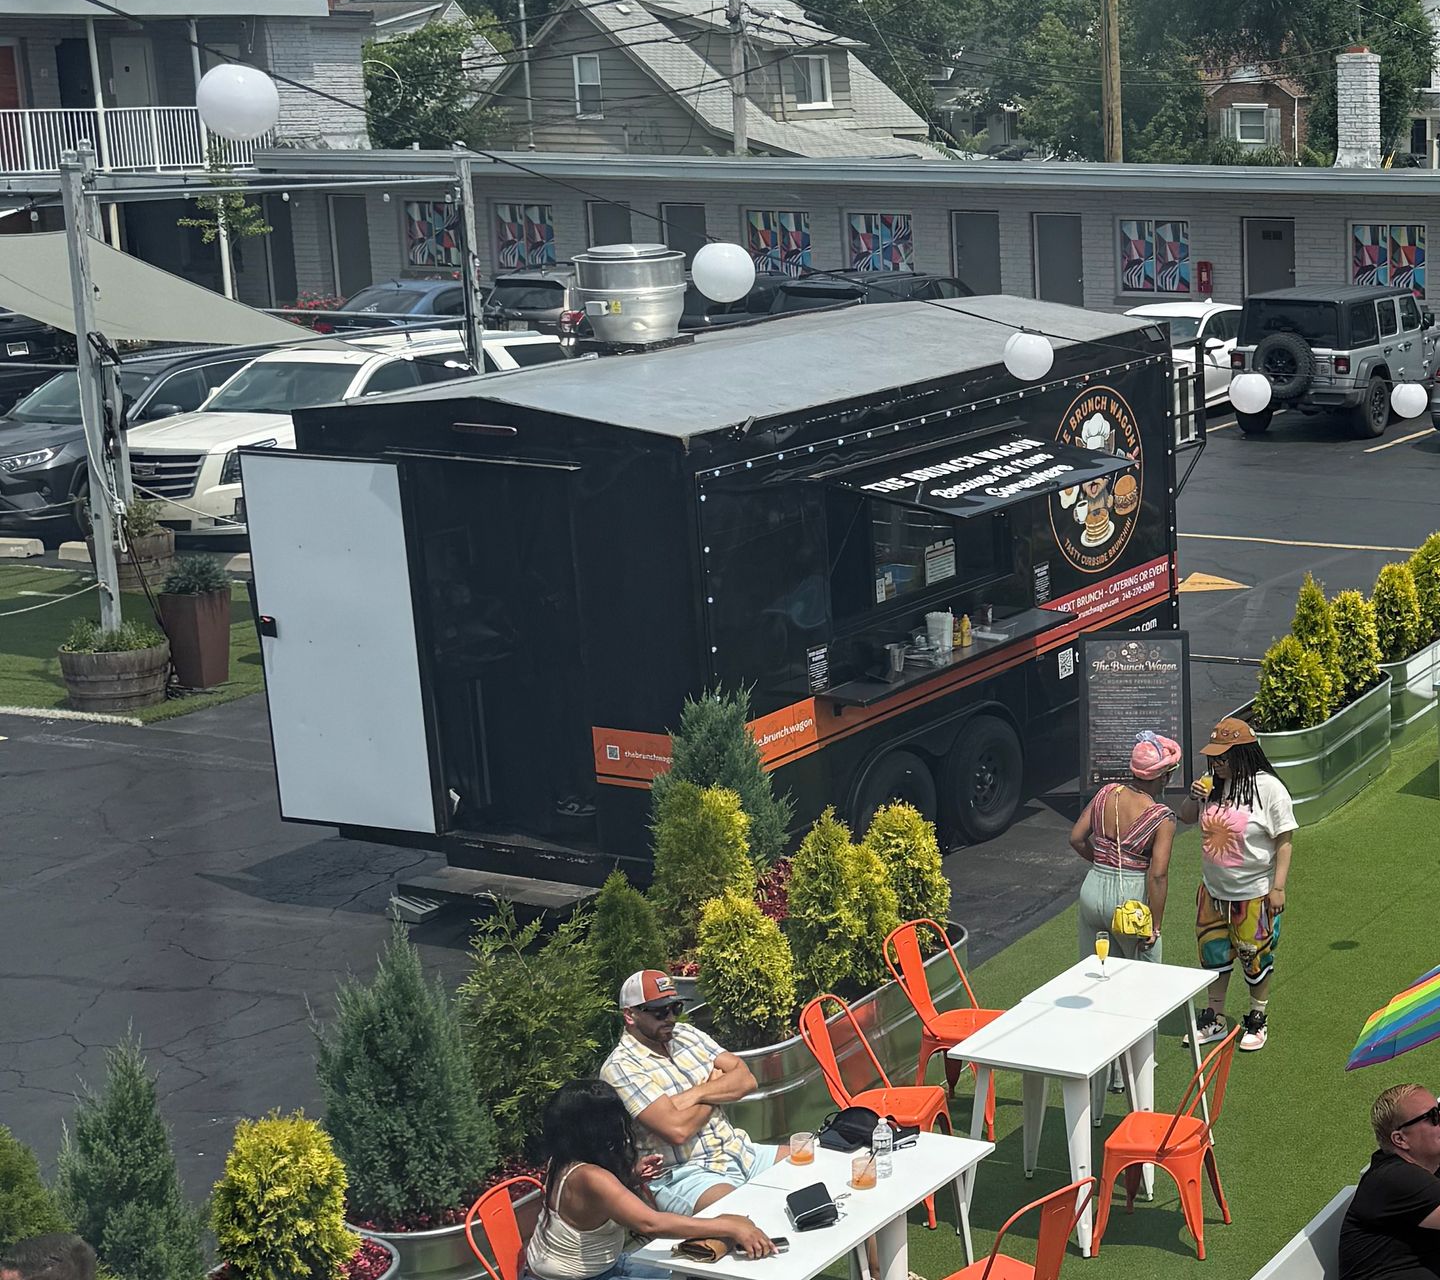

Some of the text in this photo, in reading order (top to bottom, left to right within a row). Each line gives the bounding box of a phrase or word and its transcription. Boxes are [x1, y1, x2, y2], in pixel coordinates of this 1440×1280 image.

[1069, 395, 1108, 432] BRUNCH
[1109, 398, 1137, 448] WAGON
[860, 438, 1046, 493] THE BRUNCH WAGON
[984, 463, 1075, 499] Somewhere
[929, 474, 1000, 500] Because
[1064, 537, 1082, 561] TASTY
[1080, 552, 1109, 567] CURBSIDE
[1057, 600, 1077, 613] NEXT
[1076, 588, 1105, 608] BRUNCH
[1108, 574, 1140, 595] CATERING
[1138, 569, 1150, 583] OR
[1148, 561, 1169, 579] EVENT
[1092, 659, 1178, 674] The Brunch Wagon
